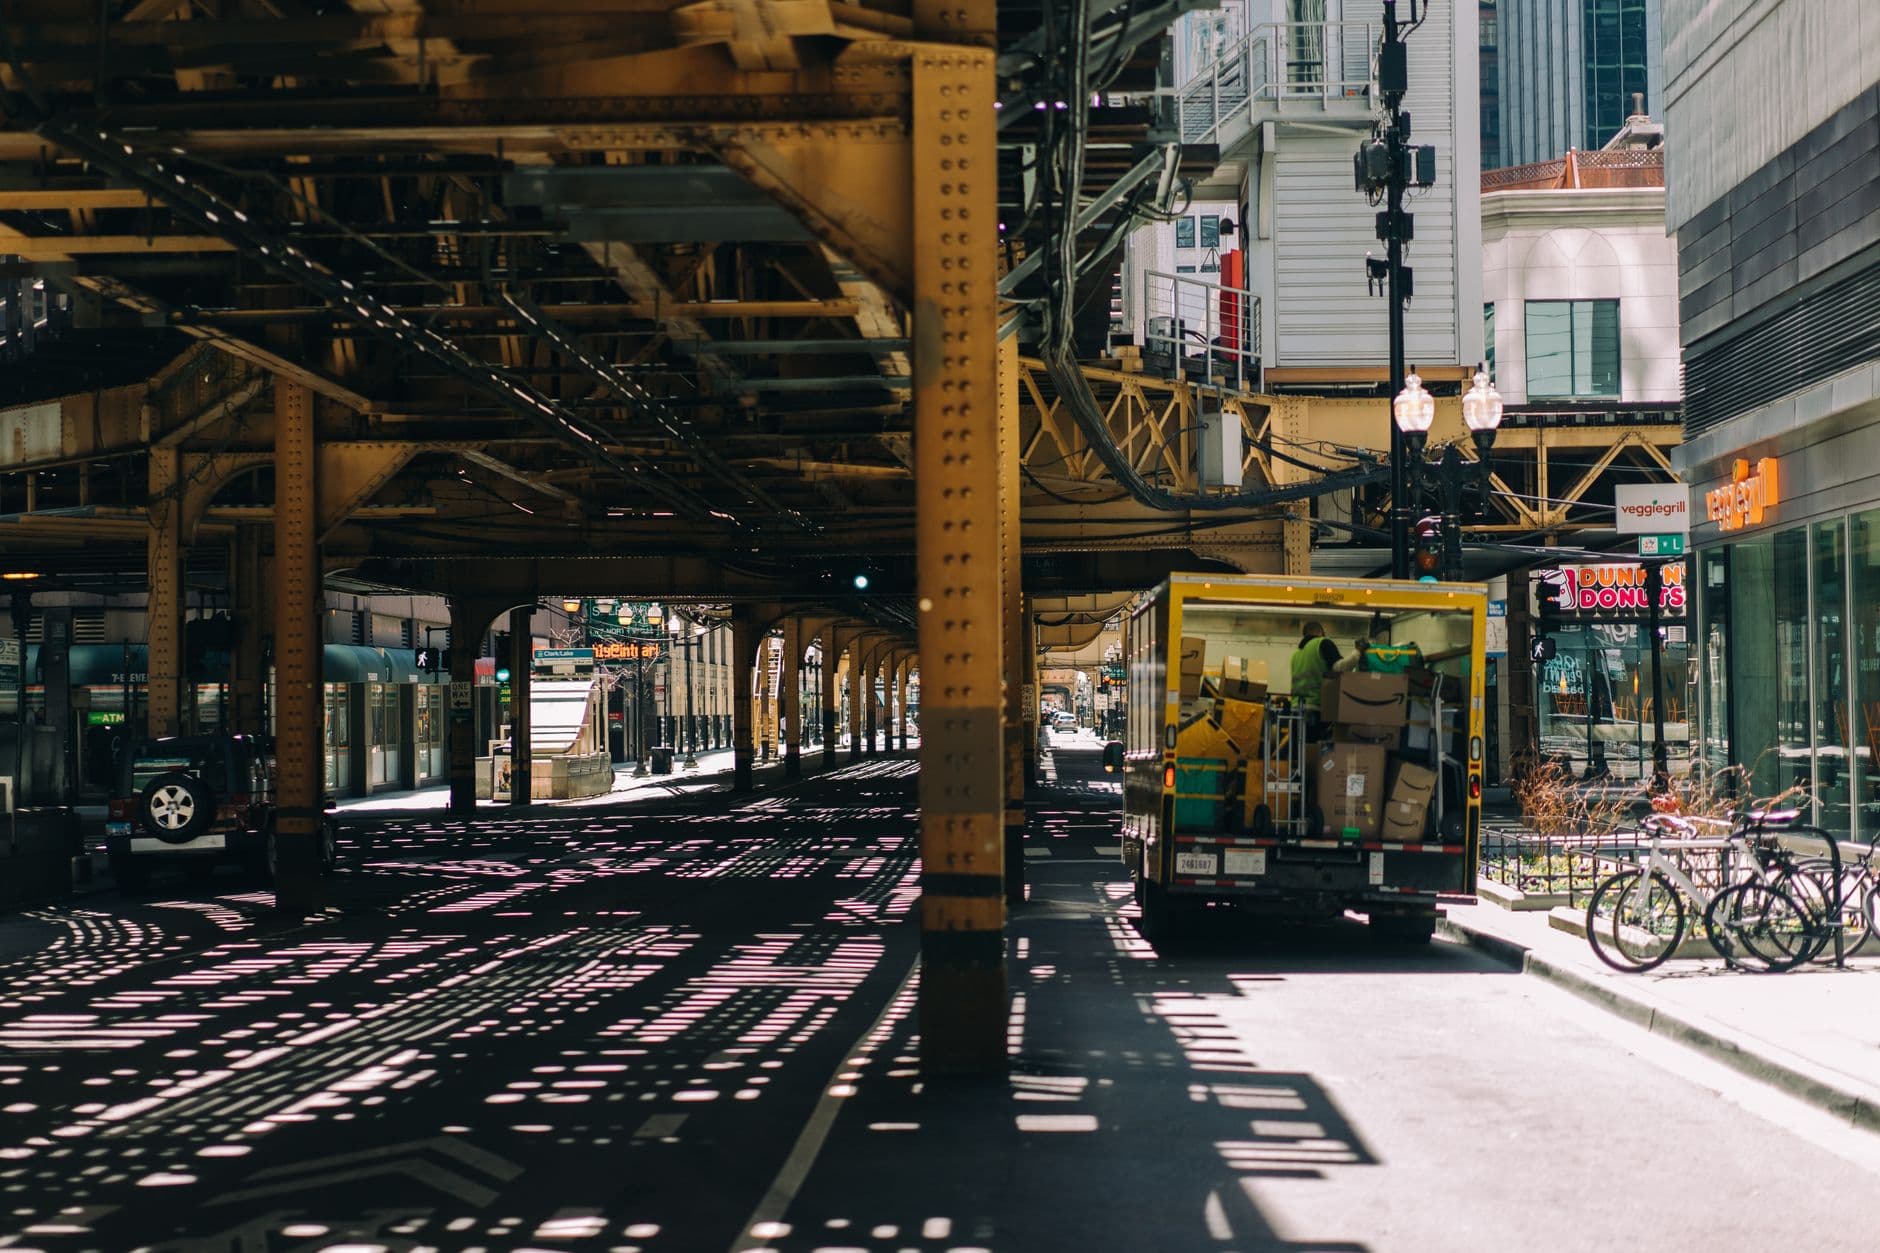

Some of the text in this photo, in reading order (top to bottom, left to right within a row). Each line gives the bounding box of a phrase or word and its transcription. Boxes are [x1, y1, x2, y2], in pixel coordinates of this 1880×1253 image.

[1621, 500, 1685, 516] veggiegrill
[1579, 565, 1686, 587] DUNKN'
[111, 673, 150, 683] 7-EEVE
[452, 682, 468, 690] ONE
[452, 690, 469, 698] WAY
[102, 713, 125, 722] ATM
